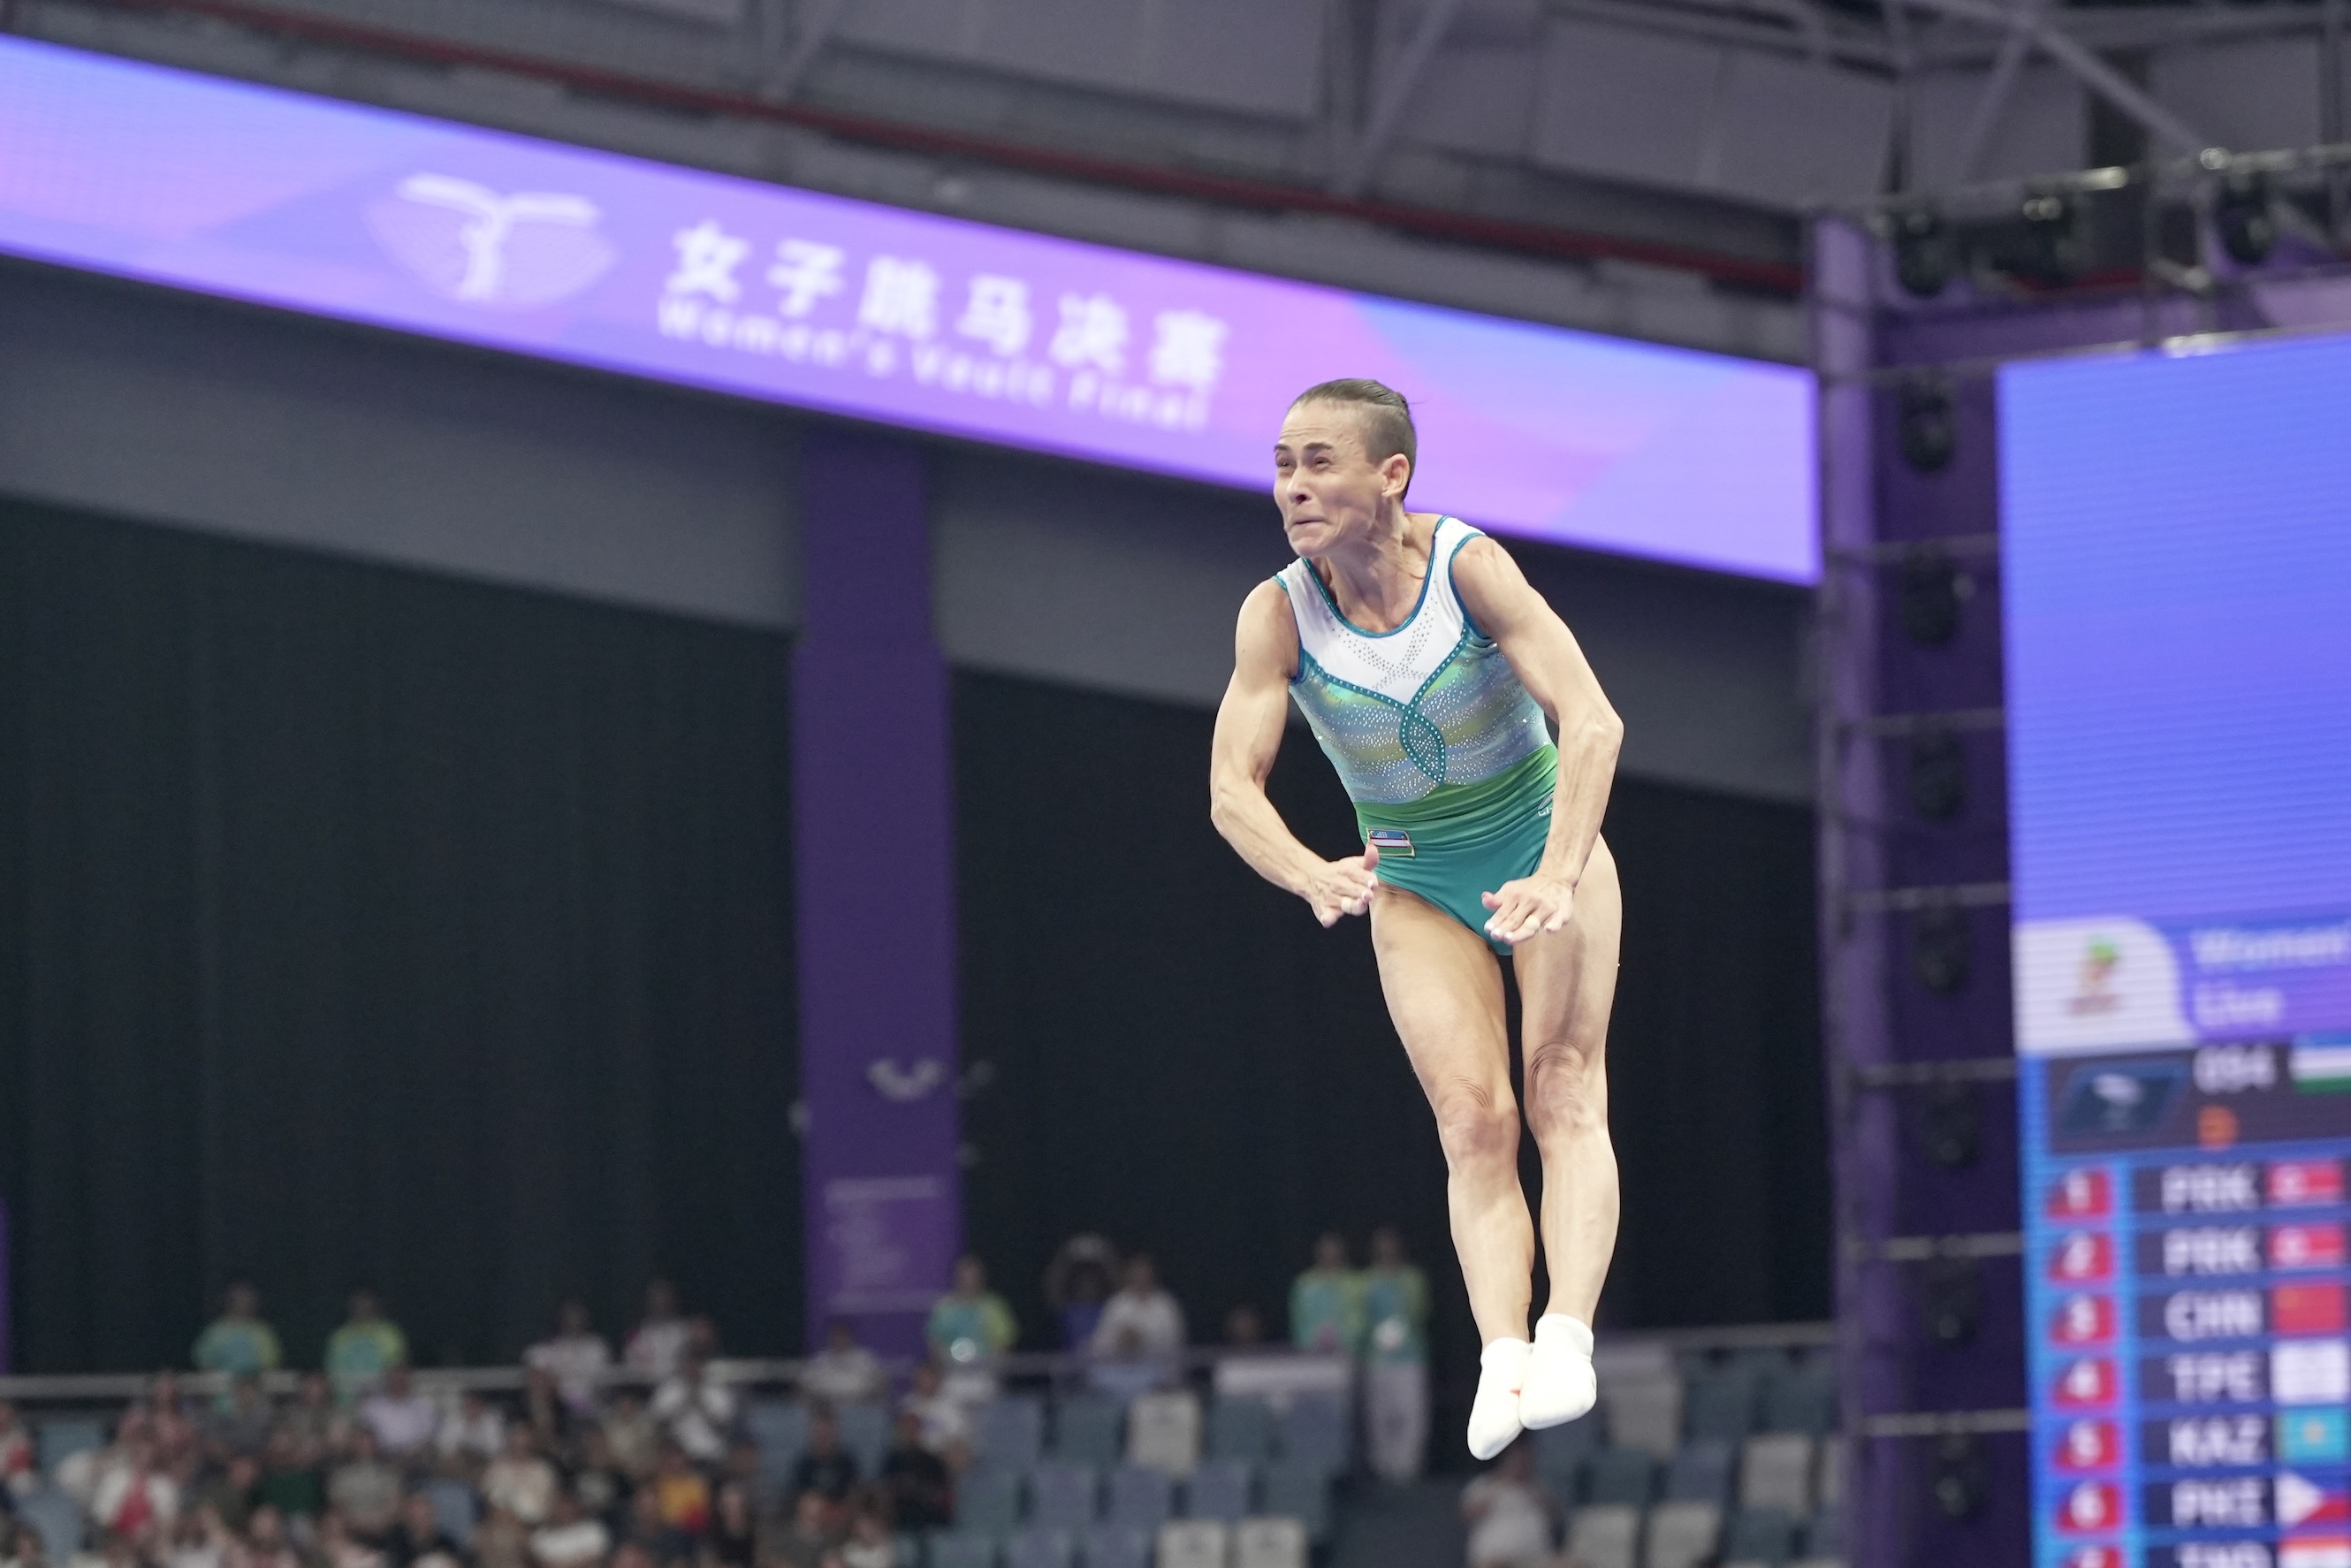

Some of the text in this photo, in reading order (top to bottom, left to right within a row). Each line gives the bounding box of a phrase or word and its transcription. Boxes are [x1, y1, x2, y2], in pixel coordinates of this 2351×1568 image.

[665, 219, 1229, 391] 女子跳马决赛
[658, 292, 1211, 432] Women's Vault Final
[2165, 1289, 2264, 1343] CHN
[2169, 1413, 2264, 1467] KAZ
